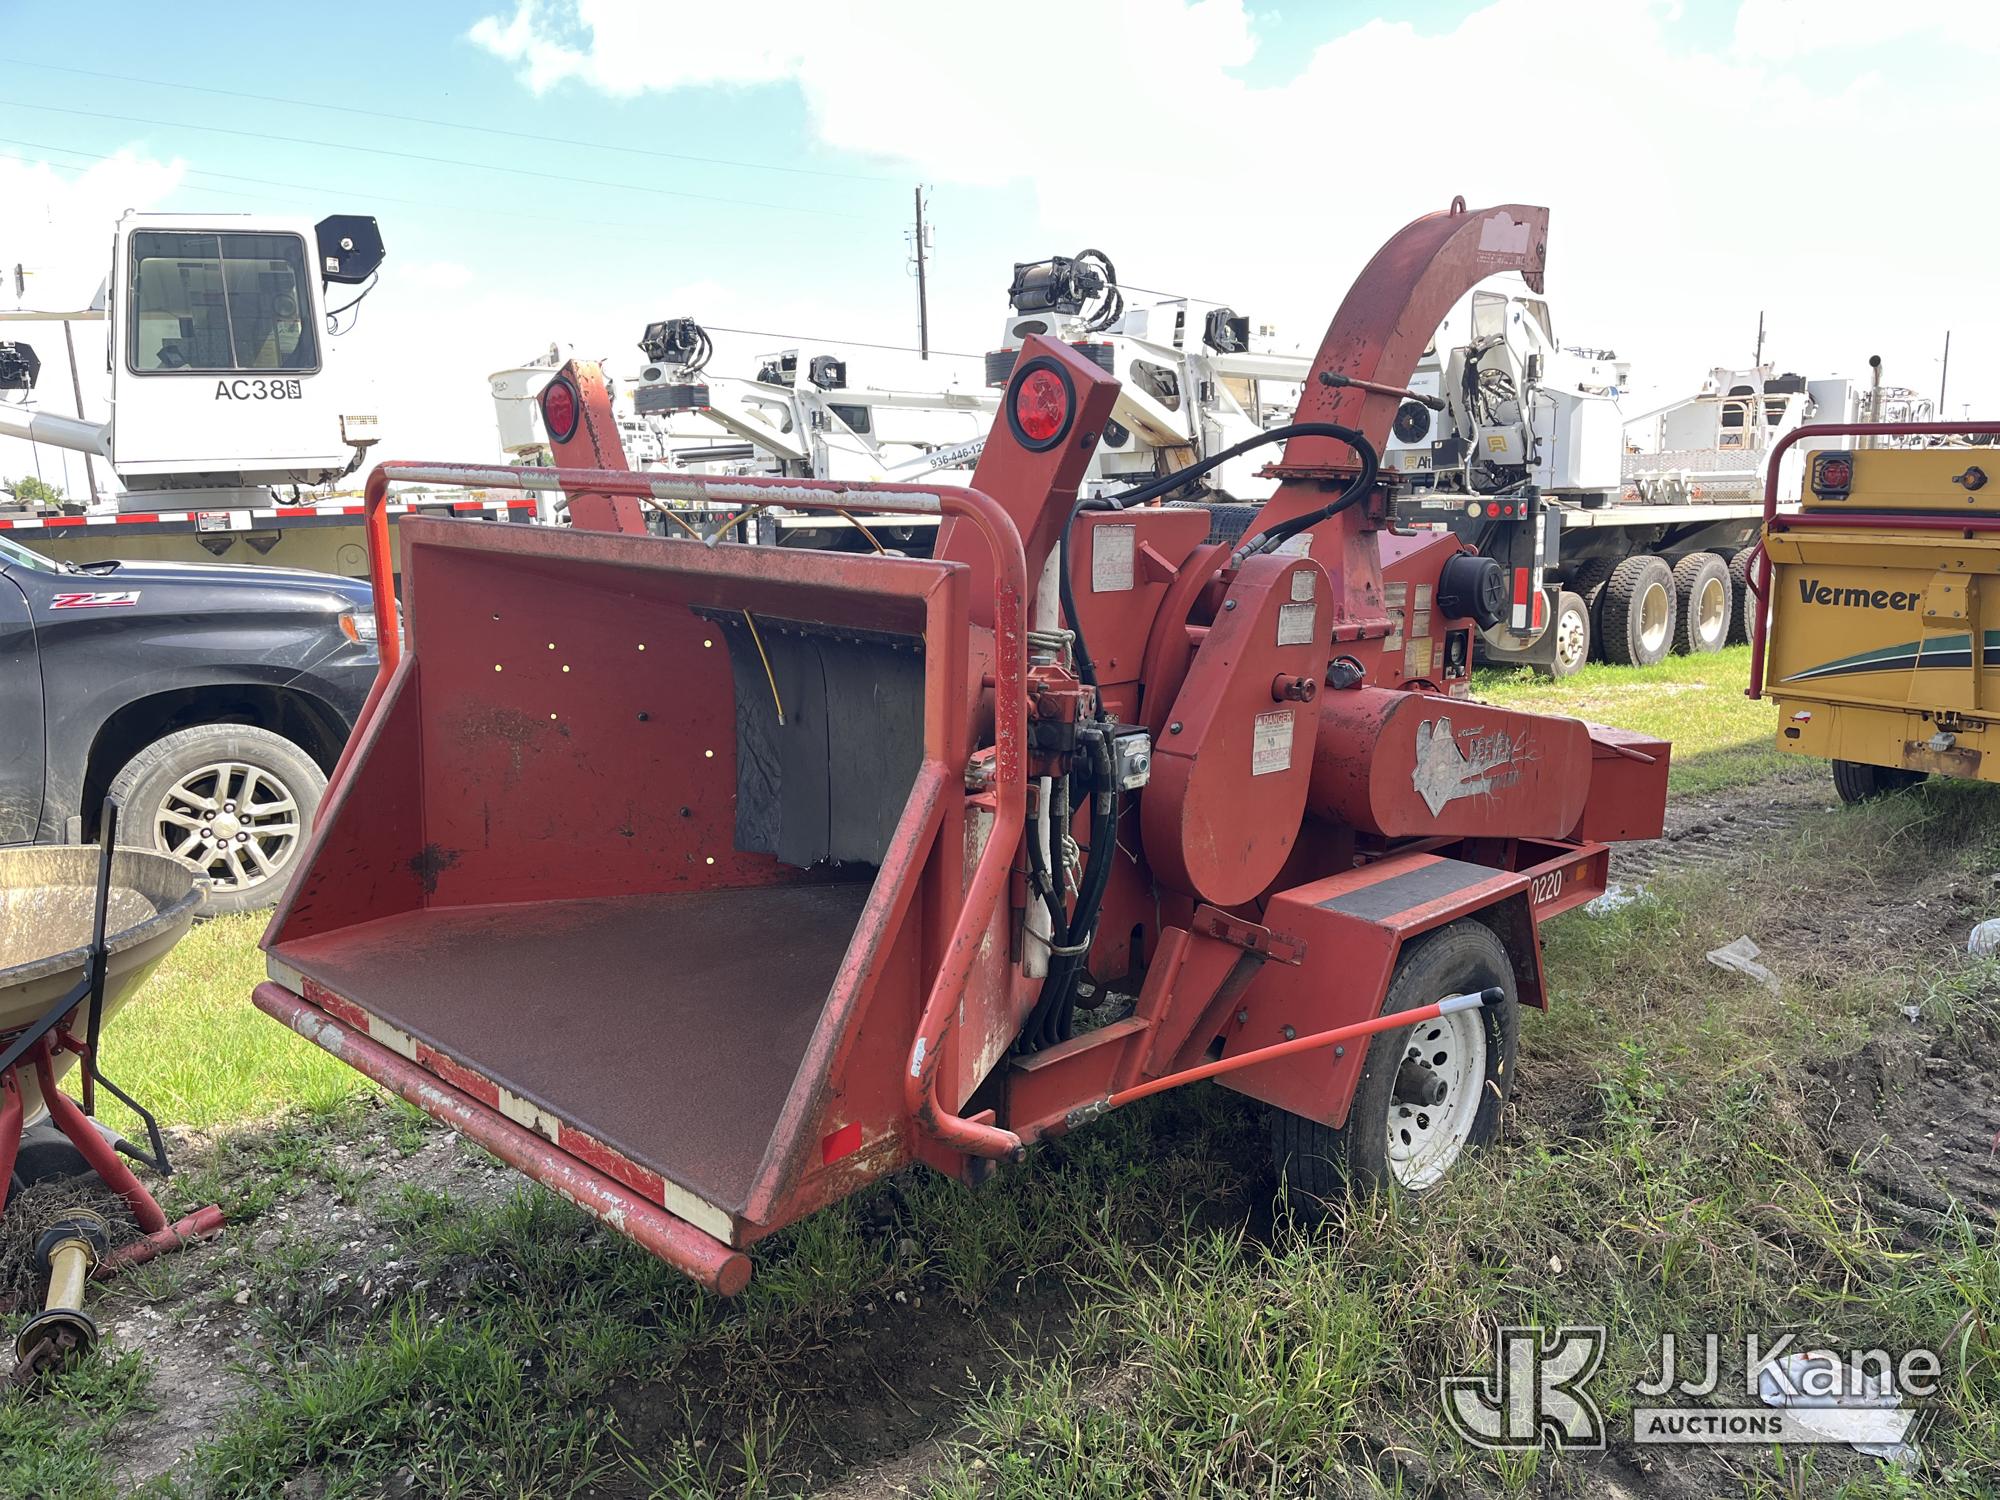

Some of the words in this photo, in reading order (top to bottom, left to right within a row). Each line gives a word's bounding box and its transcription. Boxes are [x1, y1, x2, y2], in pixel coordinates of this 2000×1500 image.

[215, 379, 286, 400] AC38
[930, 441, 986, 469] 936-446-12
[1799, 579, 1921, 611] Vermeer
[1263, 711, 1291, 726] DANGER
